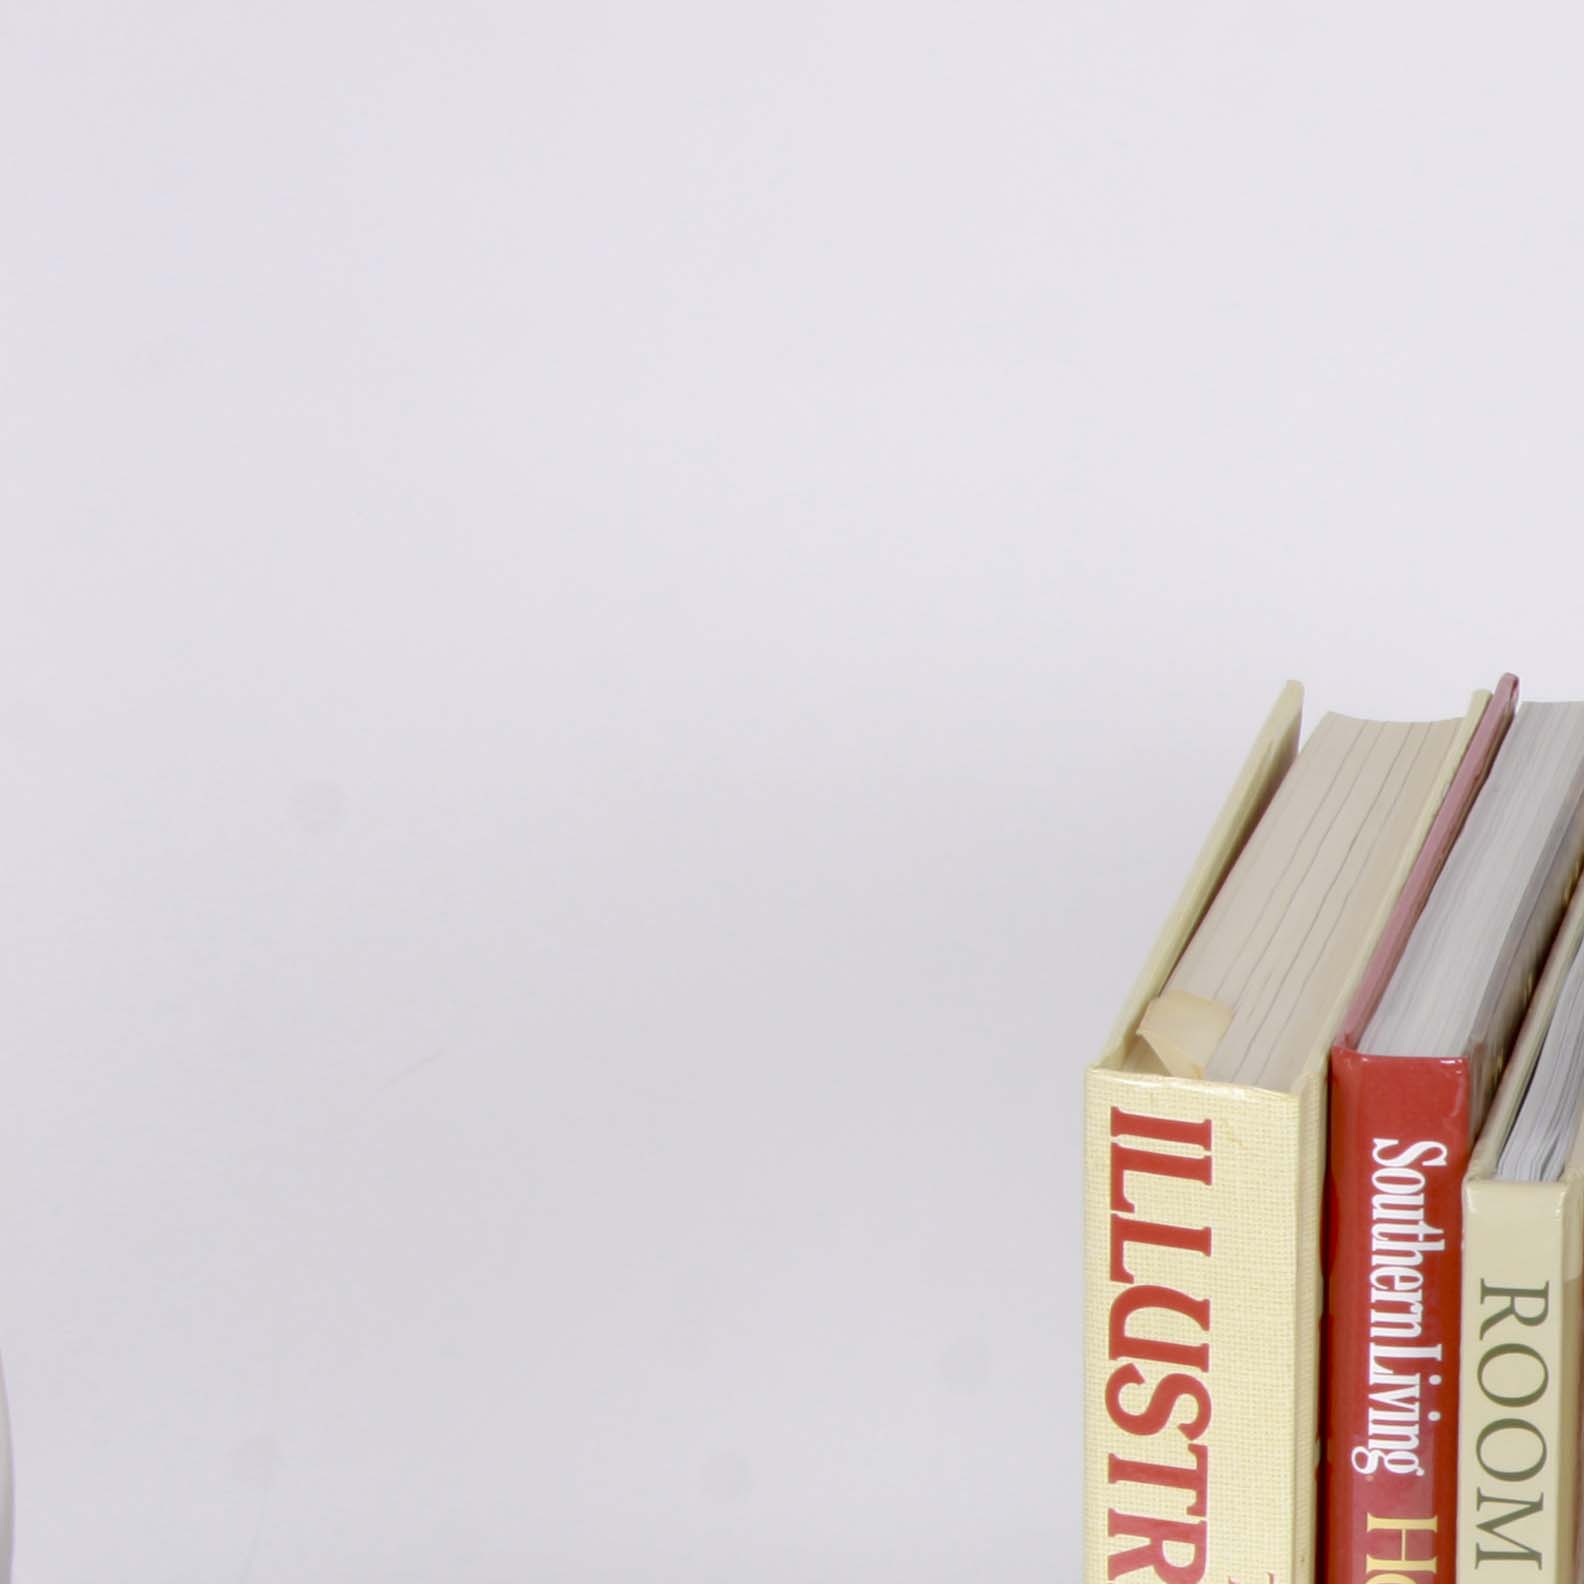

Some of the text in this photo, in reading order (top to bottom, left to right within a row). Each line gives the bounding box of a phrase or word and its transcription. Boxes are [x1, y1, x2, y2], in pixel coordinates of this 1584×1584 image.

[1352, 1138, 1446, 1477] Southern Living
[1475, 1277, 1550, 1570] ROOM
